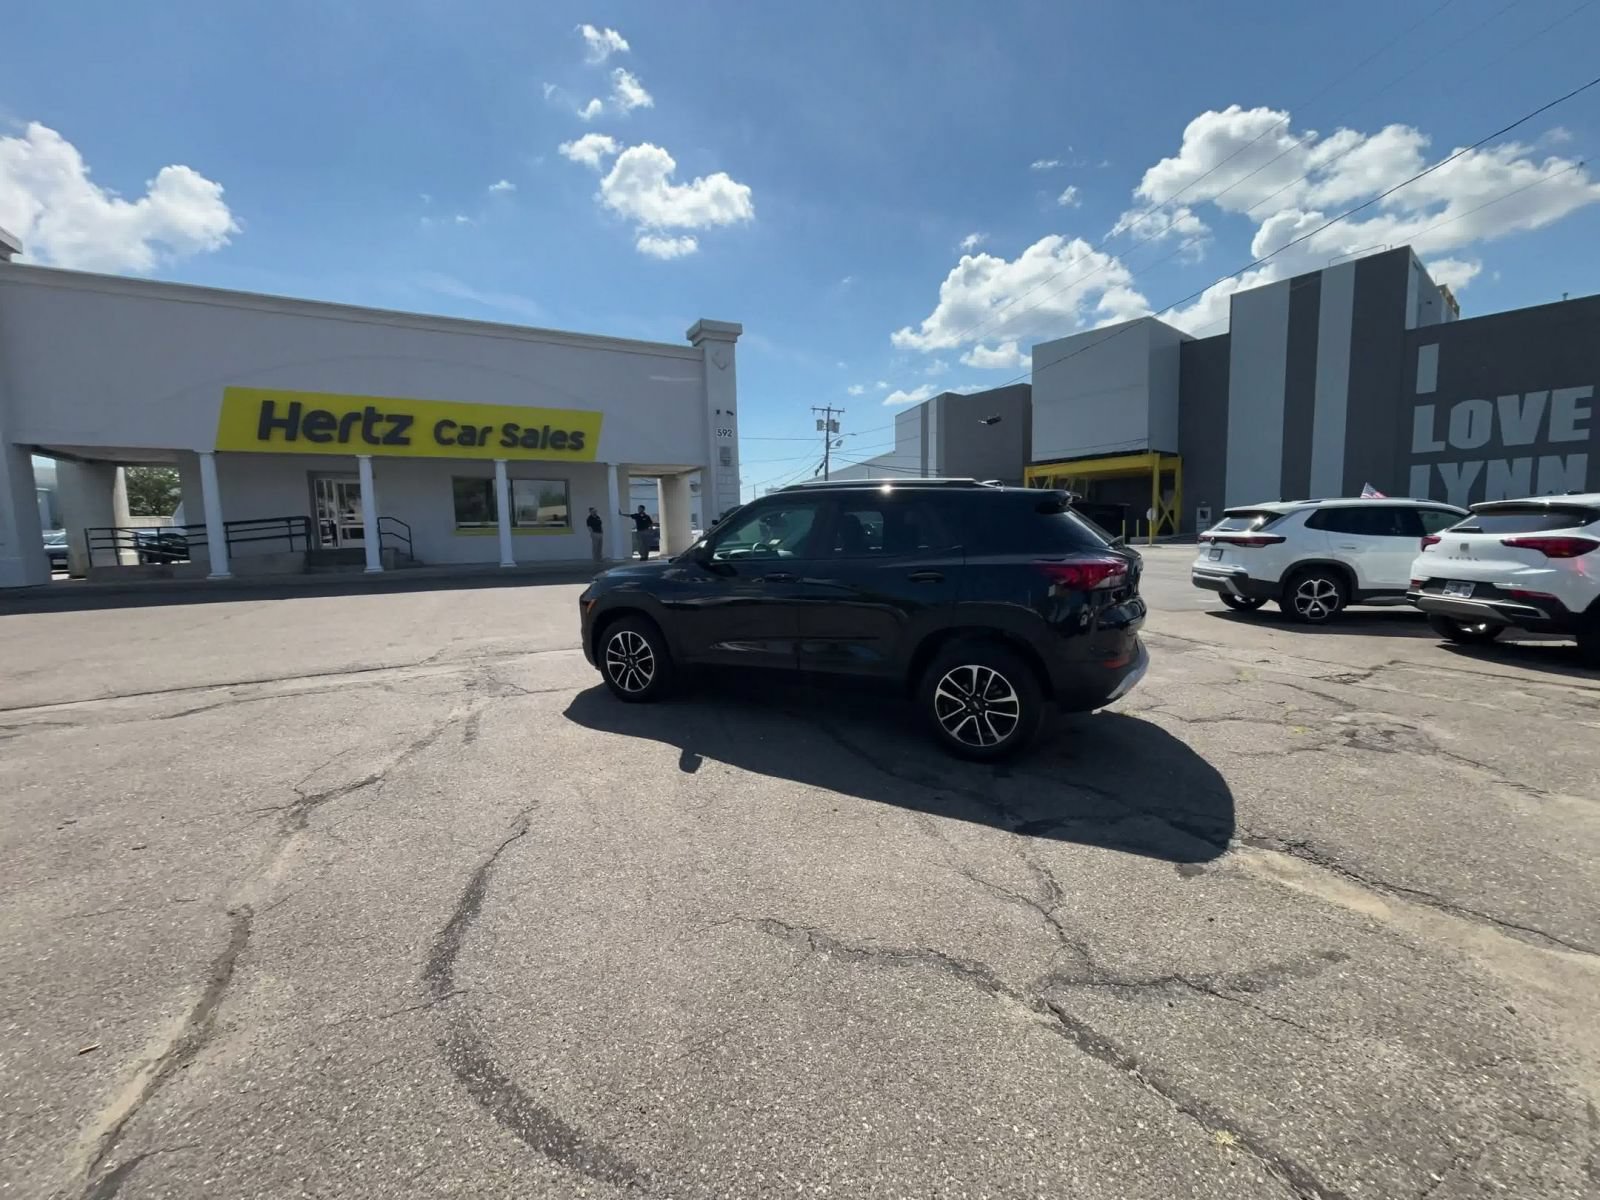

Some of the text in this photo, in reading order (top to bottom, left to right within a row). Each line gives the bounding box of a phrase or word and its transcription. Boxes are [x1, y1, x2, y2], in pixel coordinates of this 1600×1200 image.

[1416, 343, 1440, 394] I
[257, 400, 586, 451] Hertz Car Sales
[717, 428, 733, 438] 592
[1411, 385, 1594, 454] LOVE
